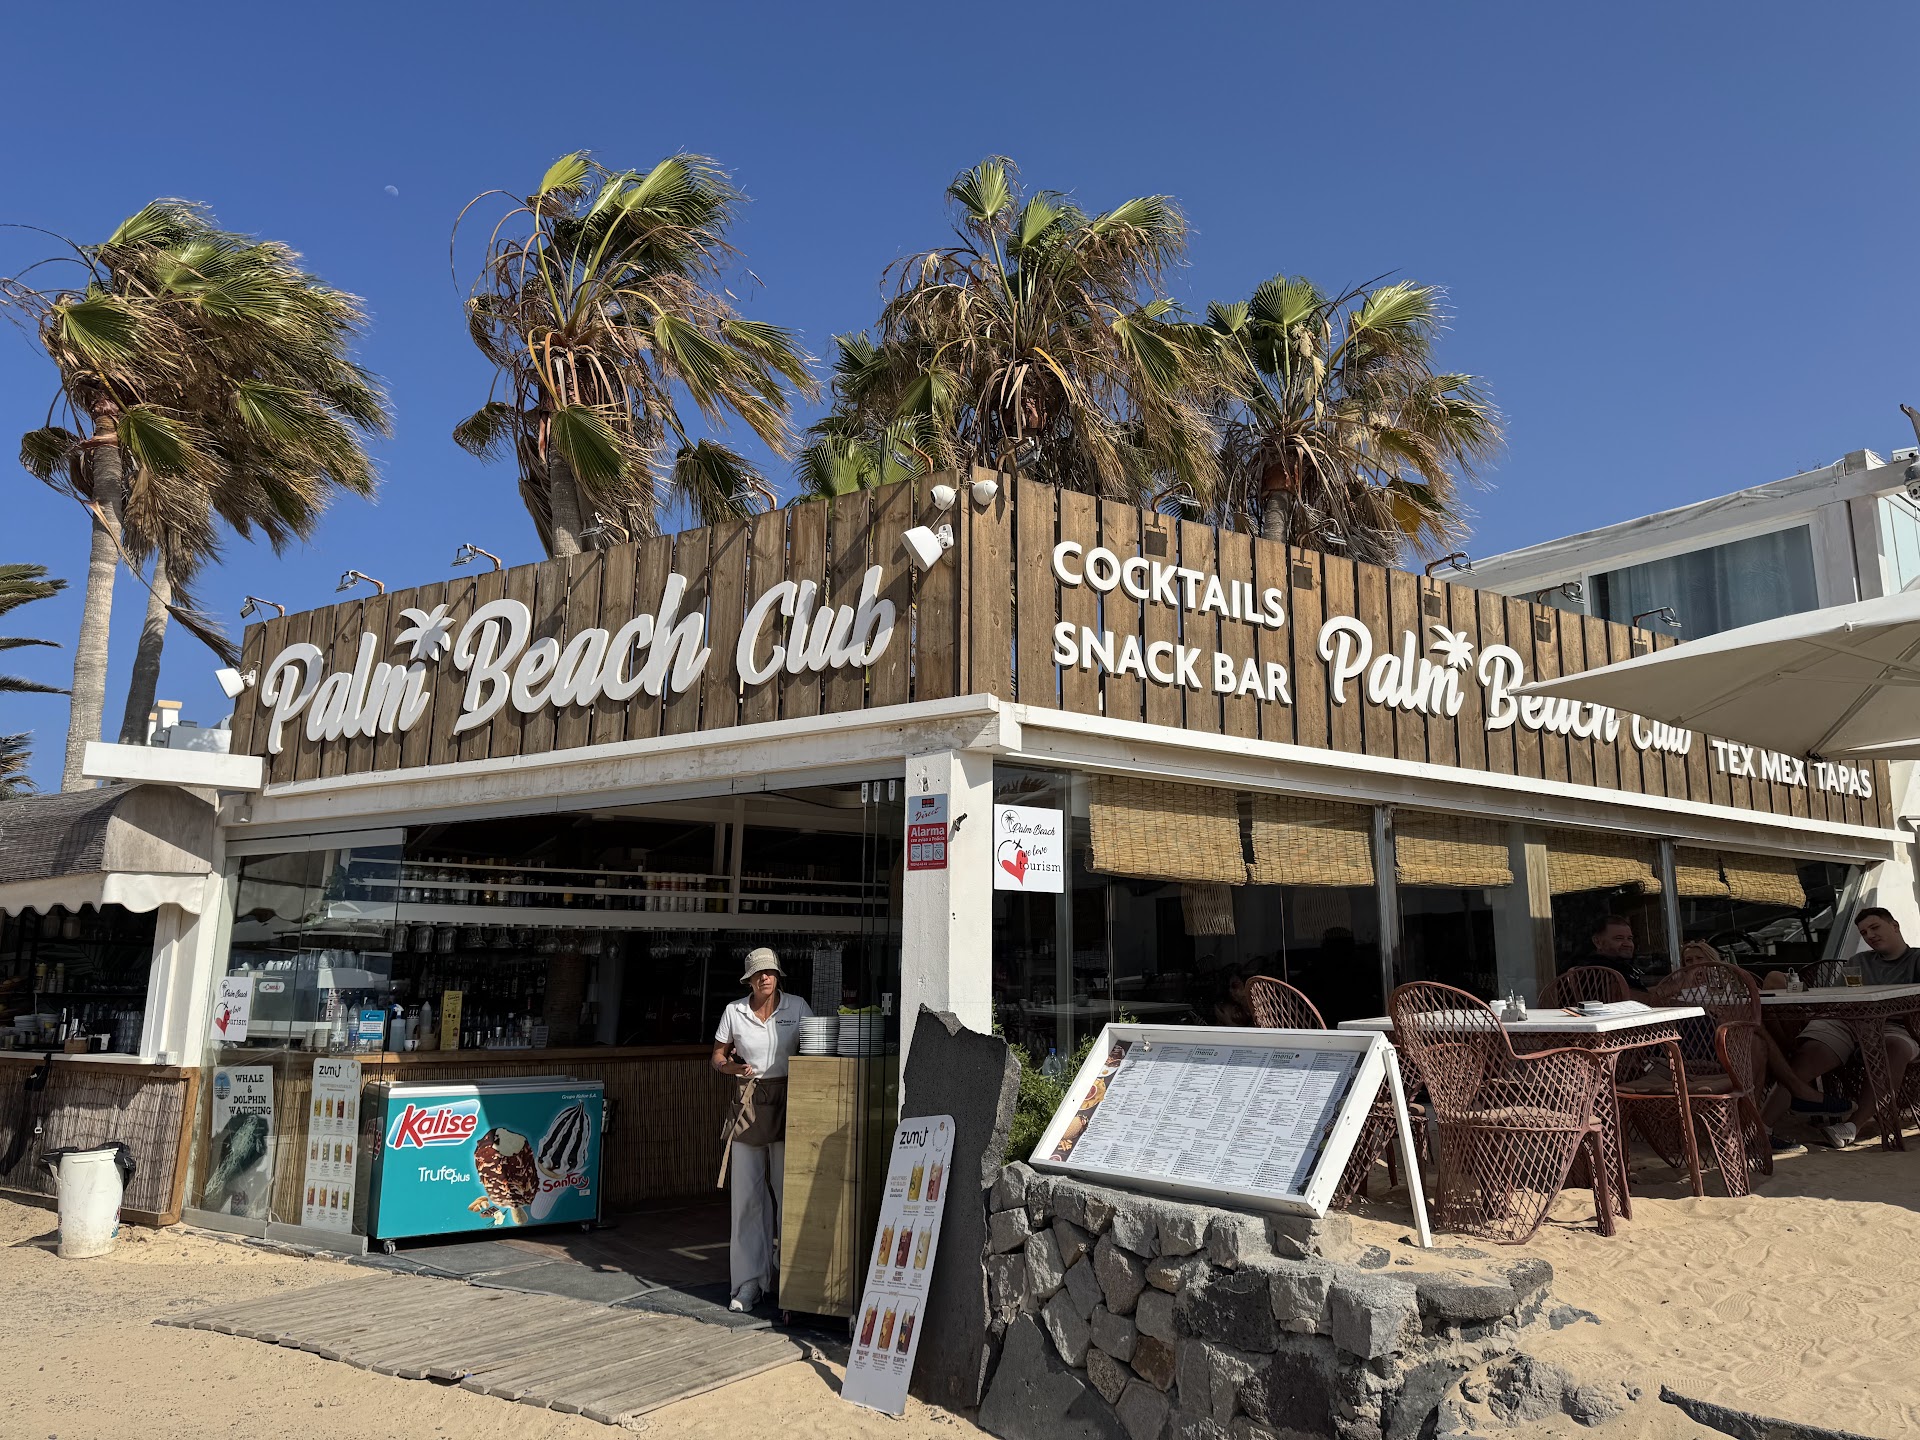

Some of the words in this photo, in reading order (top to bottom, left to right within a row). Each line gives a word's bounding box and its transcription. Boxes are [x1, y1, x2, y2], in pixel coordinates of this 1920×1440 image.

[1052, 541, 1285, 628] COCKTAILS
[262, 632, 430, 754] Palm
[453, 573, 711, 736] Beach
[737, 565, 896, 685] Club
[1052, 622, 1203, 691] SNACK
[1212, 651, 1292, 705] BAR
[1317, 616, 1464, 717] Palm
[1710, 740, 1756, 777] TEX
[1759, 750, 1807, 787] MEX
[1812, 762, 1872, 799] TAPAS
[911, 826, 945, 837] Alarma
[1012, 823, 1032, 835] Palm
[1033, 824, 1056, 836] Beach
[1021, 850, 1032, 859] we
[1032, 845, 1048, 857] love
[1019, 861, 1062, 873] tourism
[235, 1074, 264, 1083] WHALE
[247, 1085, 252, 1093] &
[233, 1095, 267, 1105] DOLPHIN
[229, 1106, 271, 1116] WATCHING
[395, 1105, 477, 1148] Kalise
